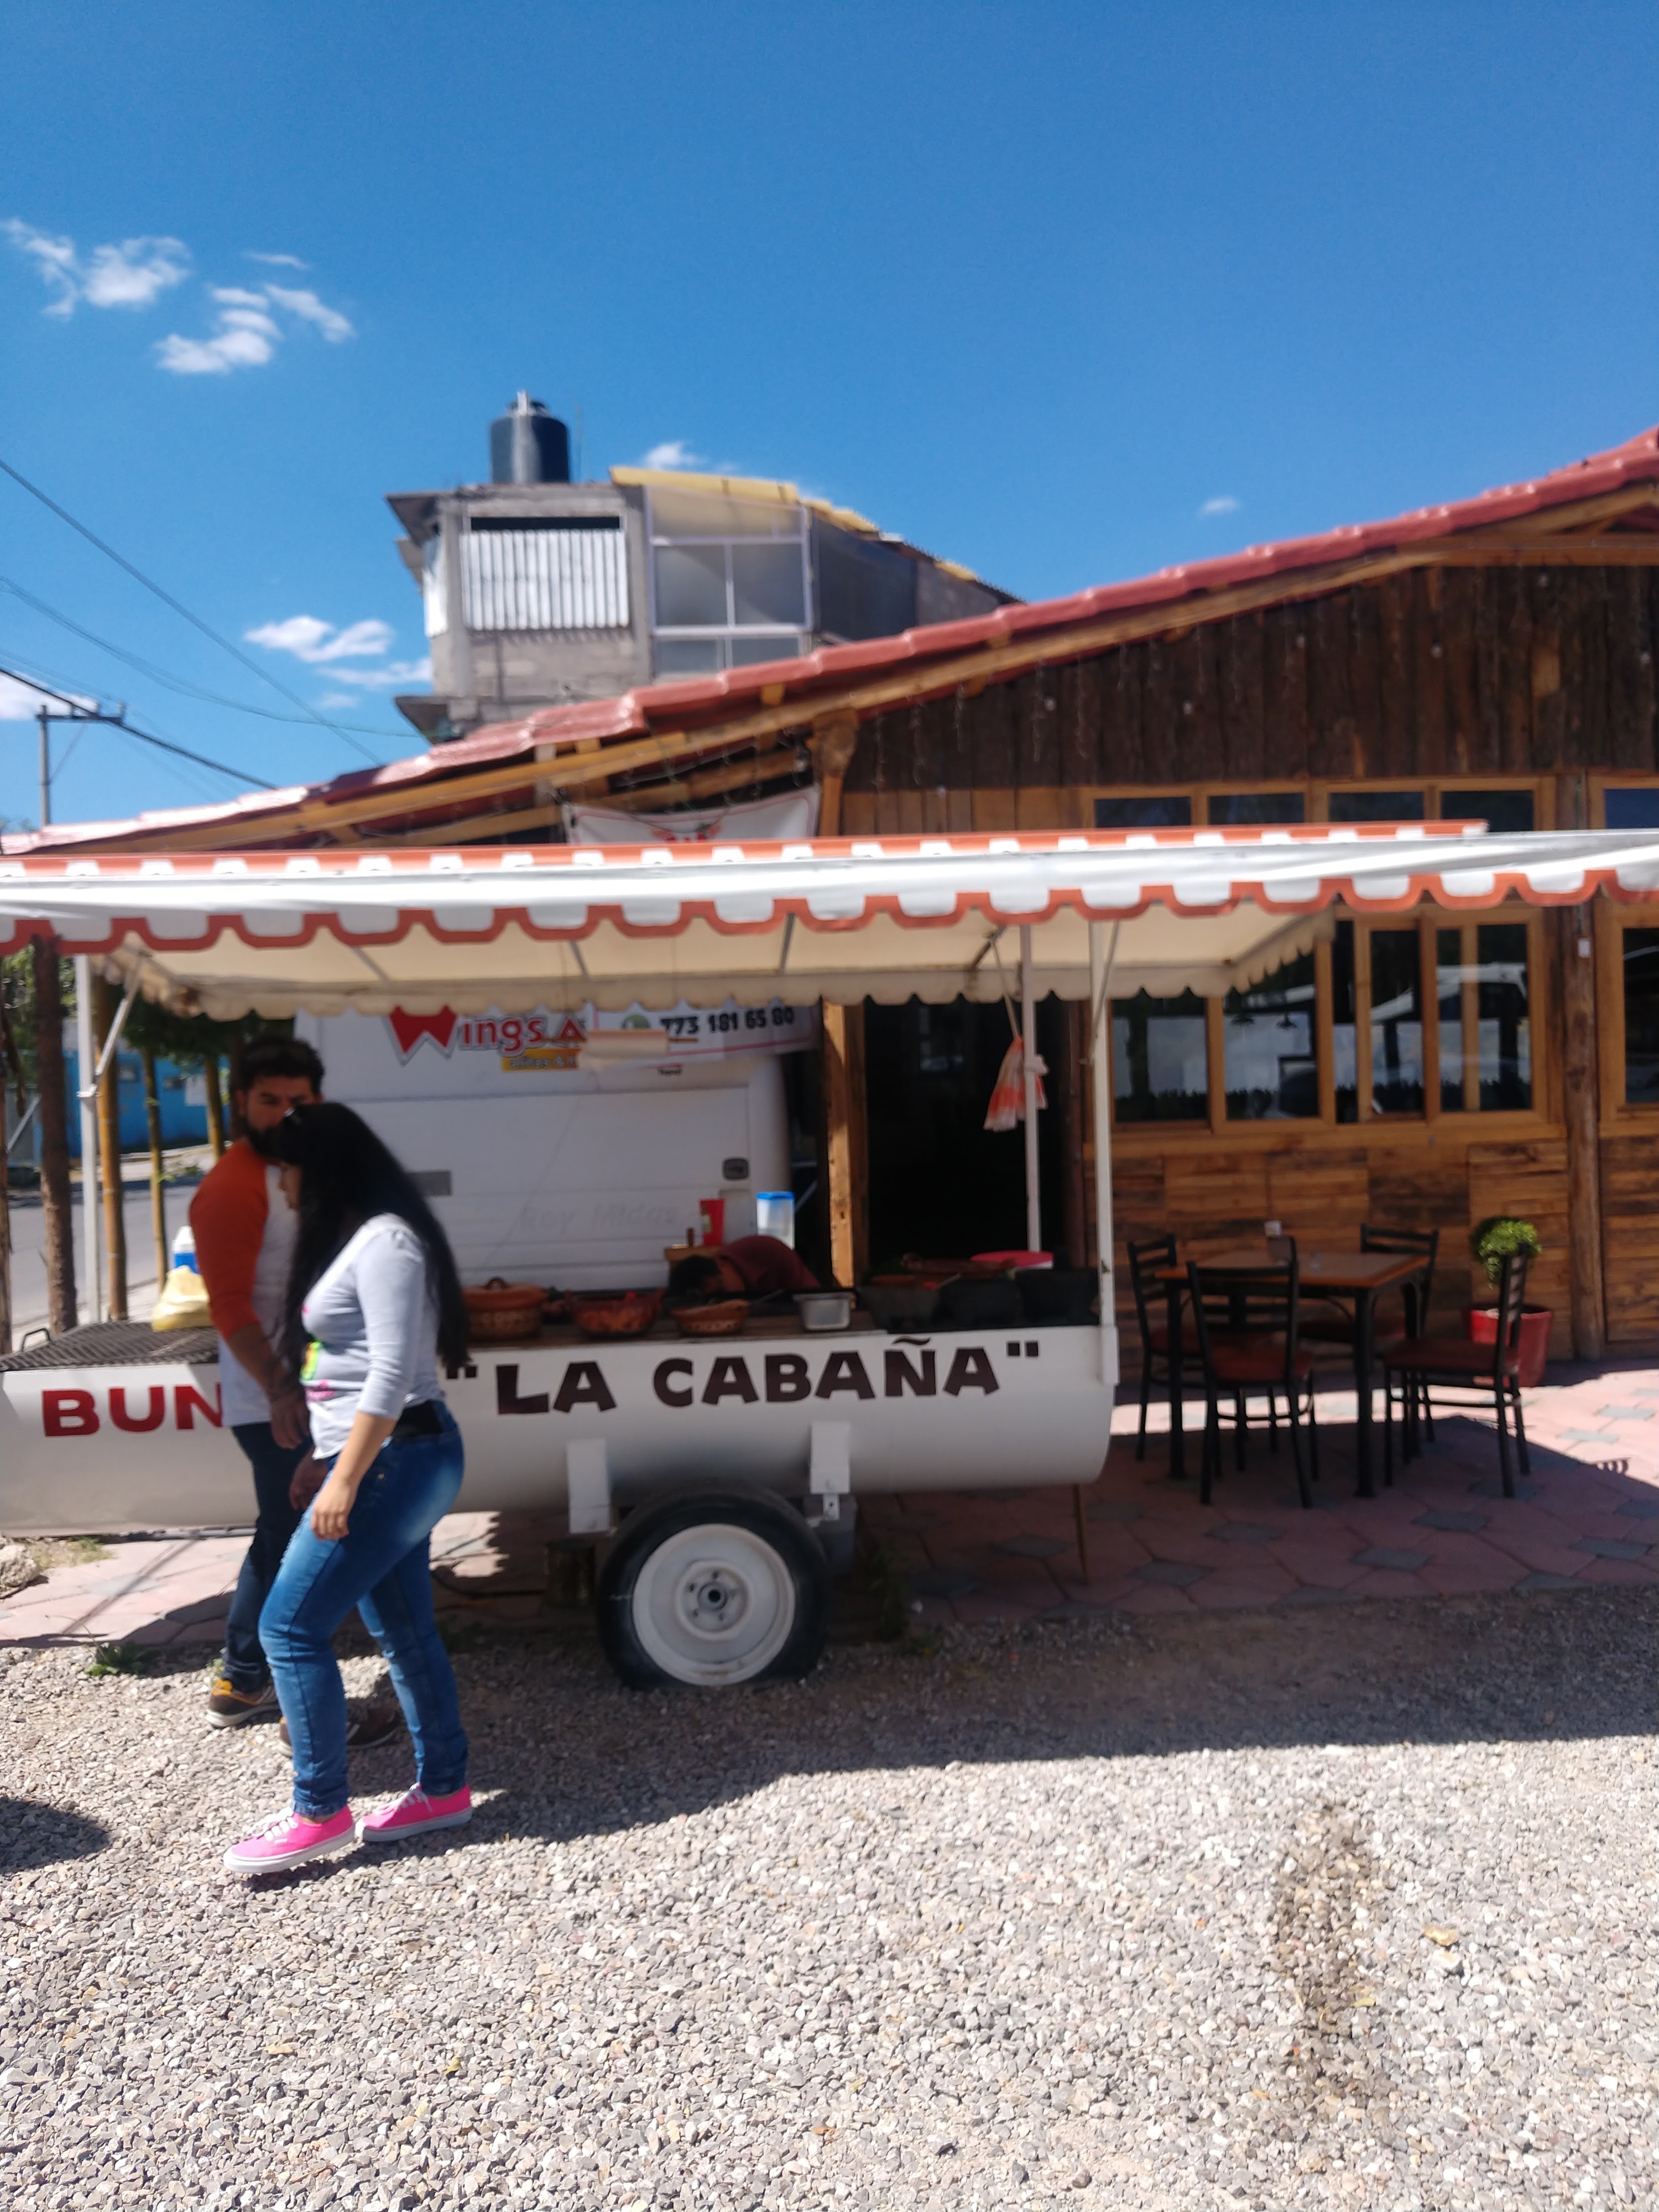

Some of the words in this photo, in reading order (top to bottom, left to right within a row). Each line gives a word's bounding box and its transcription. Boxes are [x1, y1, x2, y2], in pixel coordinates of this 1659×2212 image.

[389, 1005, 544, 1053] Wings
[660, 1015, 698, 1035] 773
[709, 1012, 738, 1033] 181
[744, 1009, 766, 1029] 65
[41, 1383, 223, 1437] BUN
[653, 1335, 1039, 1407] CABAÑA"
